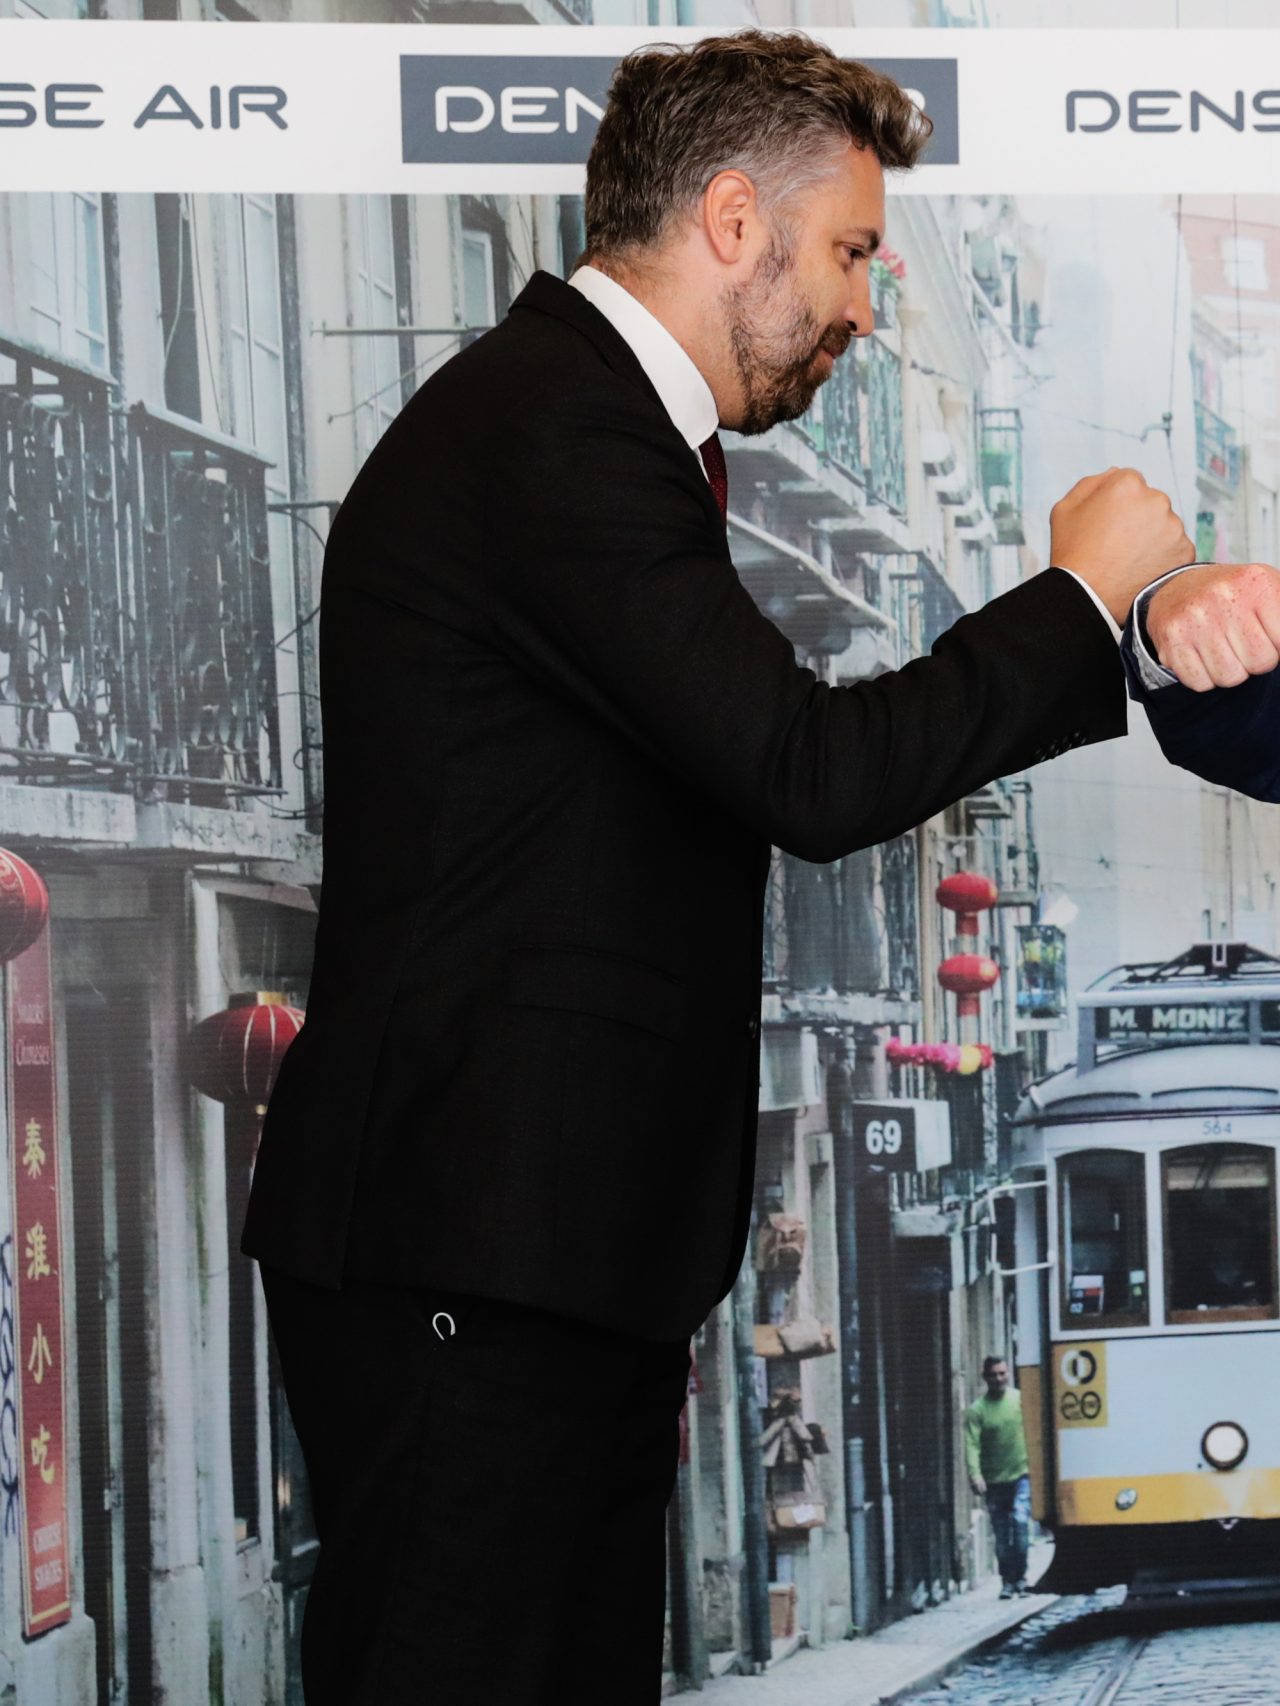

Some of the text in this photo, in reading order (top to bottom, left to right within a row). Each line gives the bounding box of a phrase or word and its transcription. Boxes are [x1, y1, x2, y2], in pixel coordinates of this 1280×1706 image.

[133, 84, 289, 130] AIR
[434, 86, 605, 134] DEN
[1109, 1007, 1138, 1029] M.
[1152, 1006, 1246, 1029] MONIZ
[865, 1119, 902, 1155] 69
[1202, 1119, 1232, 1136] 564
